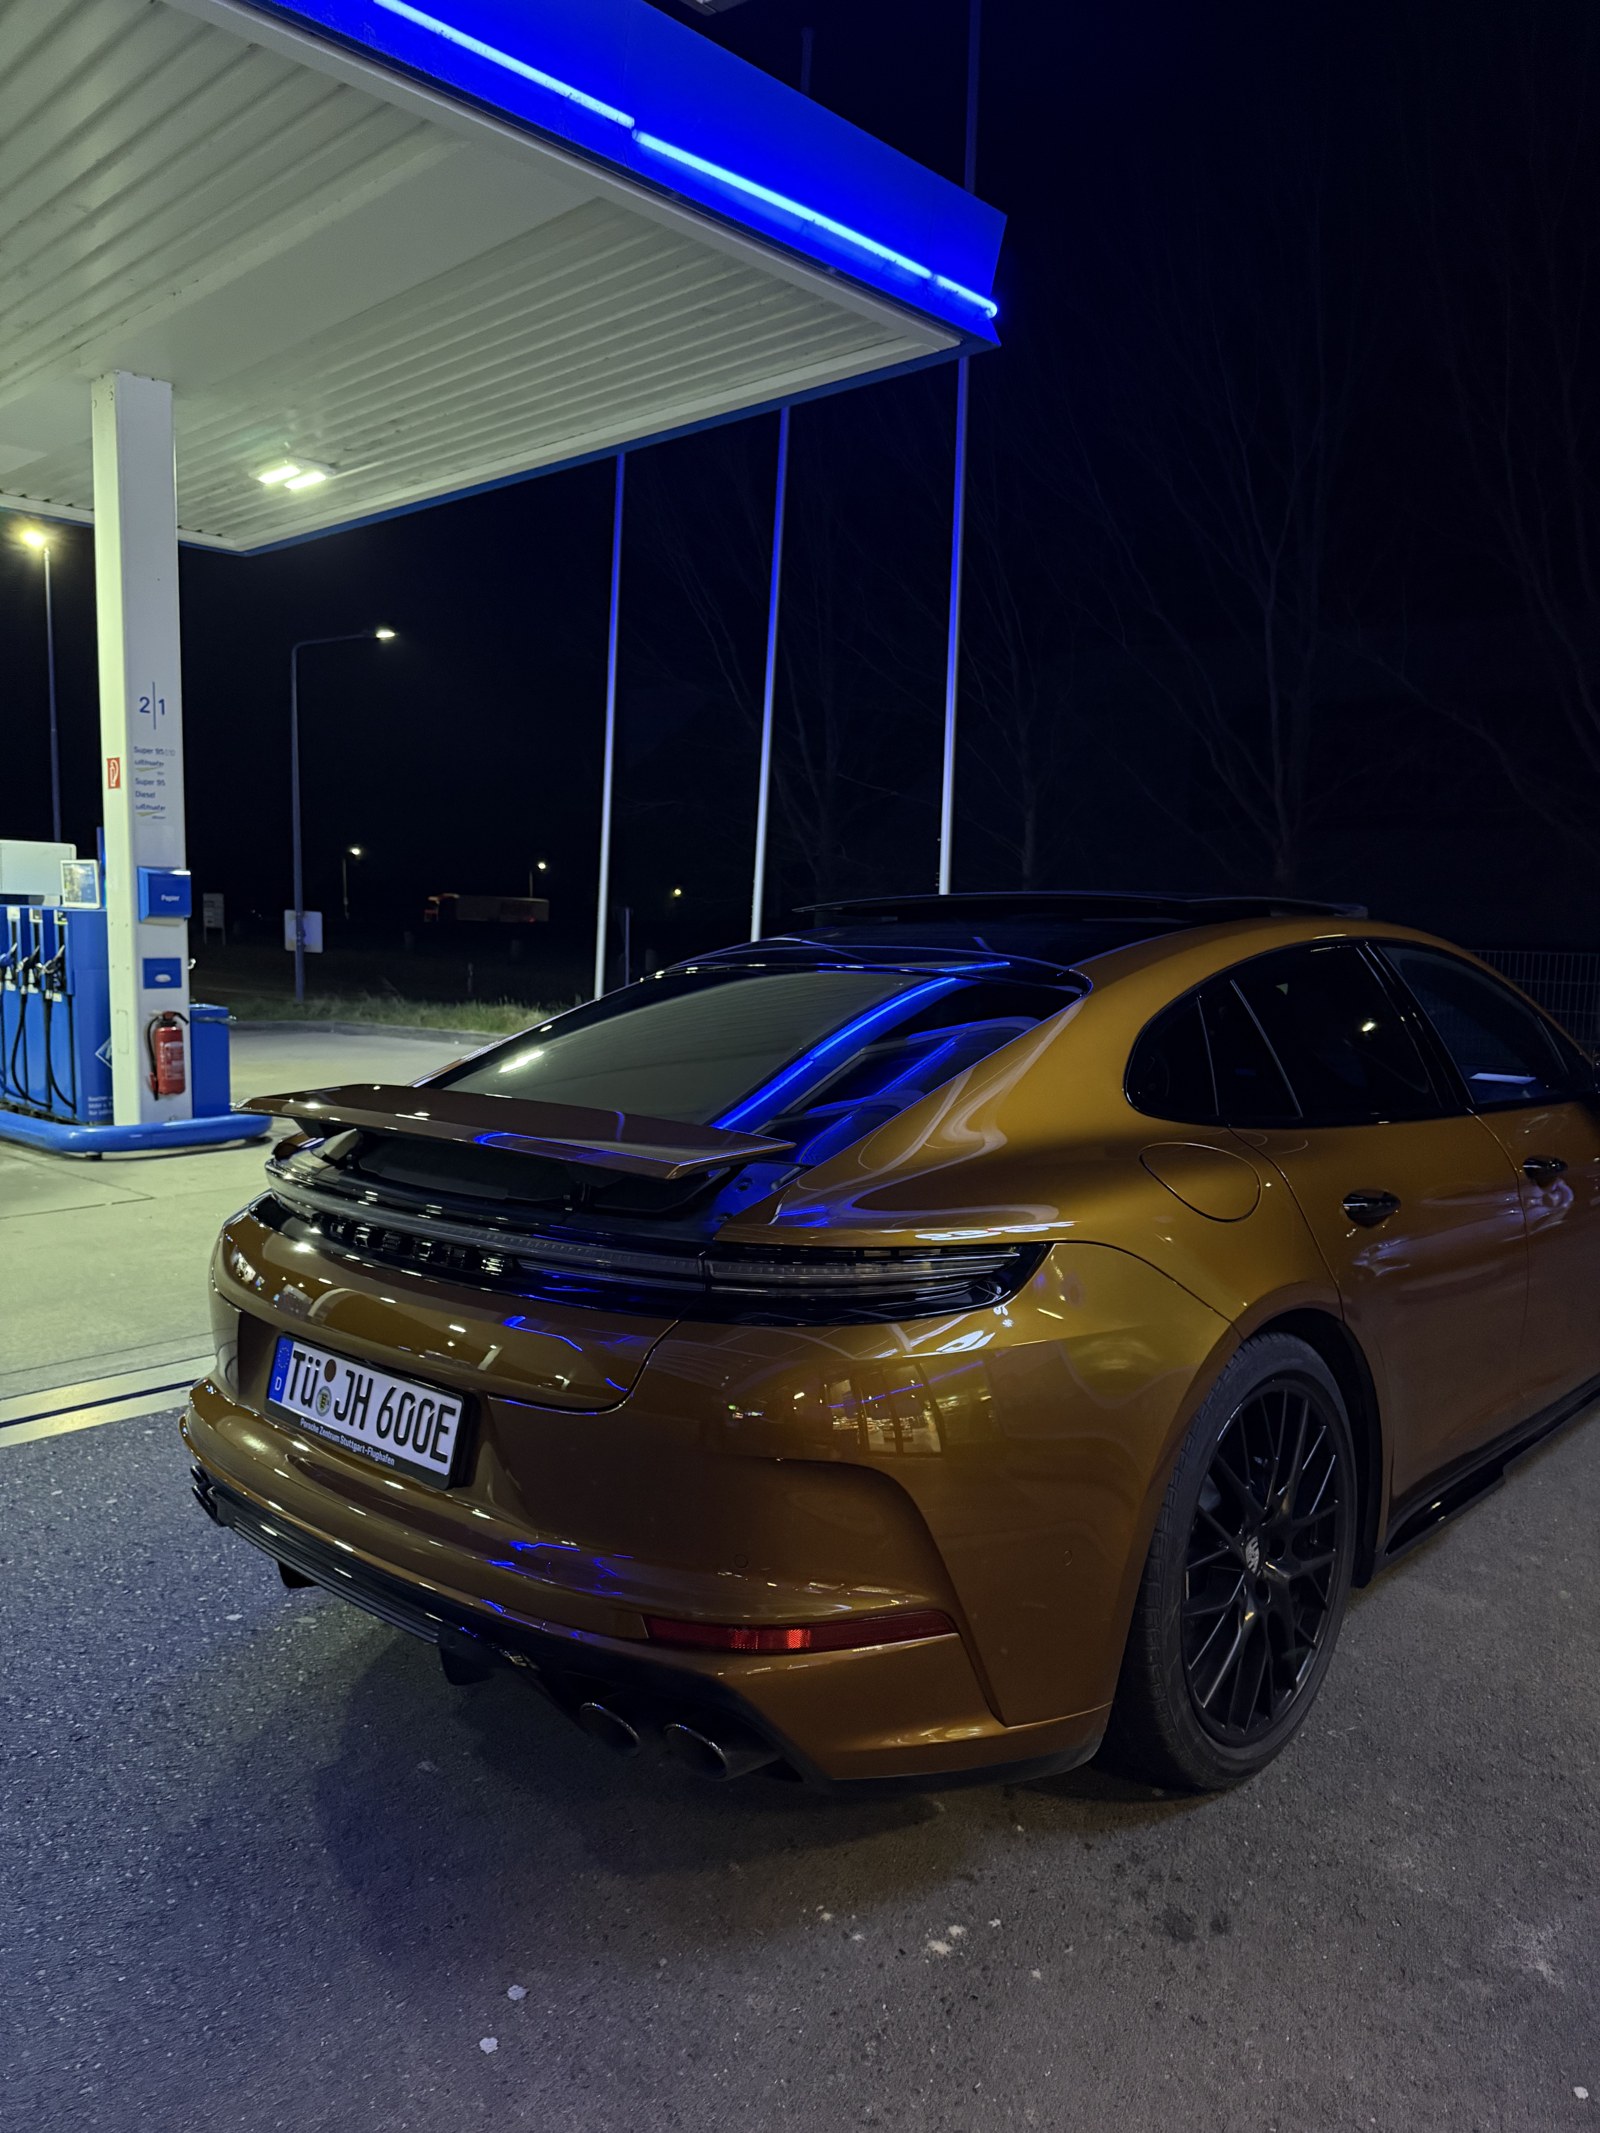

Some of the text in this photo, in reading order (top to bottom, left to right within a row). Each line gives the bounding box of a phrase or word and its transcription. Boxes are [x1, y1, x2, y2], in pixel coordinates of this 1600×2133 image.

[139, 696, 165, 716] 2 1
[133, 746, 154, 755] Super
[135, 777, 155, 787] Super
[135, 790, 156, 799] Diesel
[274, 1376, 282, 1391] D
[289, 1350, 457, 1464] TÜ JH 600E
[300, 1417, 395, 1467] Porsche Zentrum Stuttgart-Flughafen
